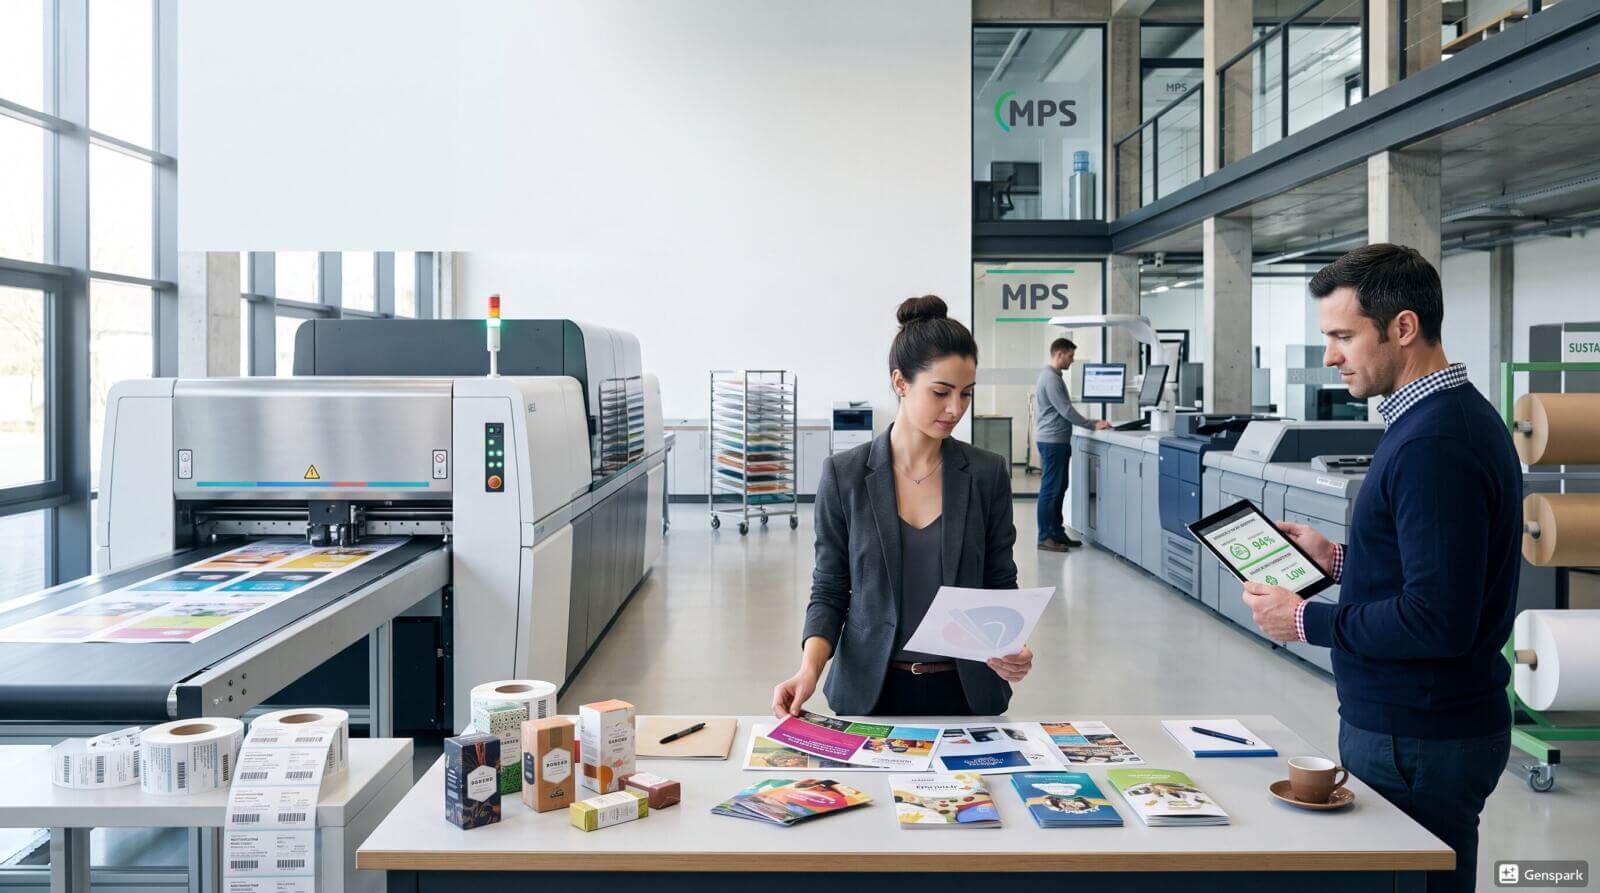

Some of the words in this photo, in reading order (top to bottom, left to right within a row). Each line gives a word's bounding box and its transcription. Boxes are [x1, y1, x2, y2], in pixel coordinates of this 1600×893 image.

[1166, 83, 1188, 92] MPS
[1009, 99, 1077, 127] MPS
[1002, 283, 1069, 311] MPS
[1569, 343, 1600, 353] SUSTA
[1252, 536, 1276, 550] 94%
[1285, 566, 1307, 581] LOW
